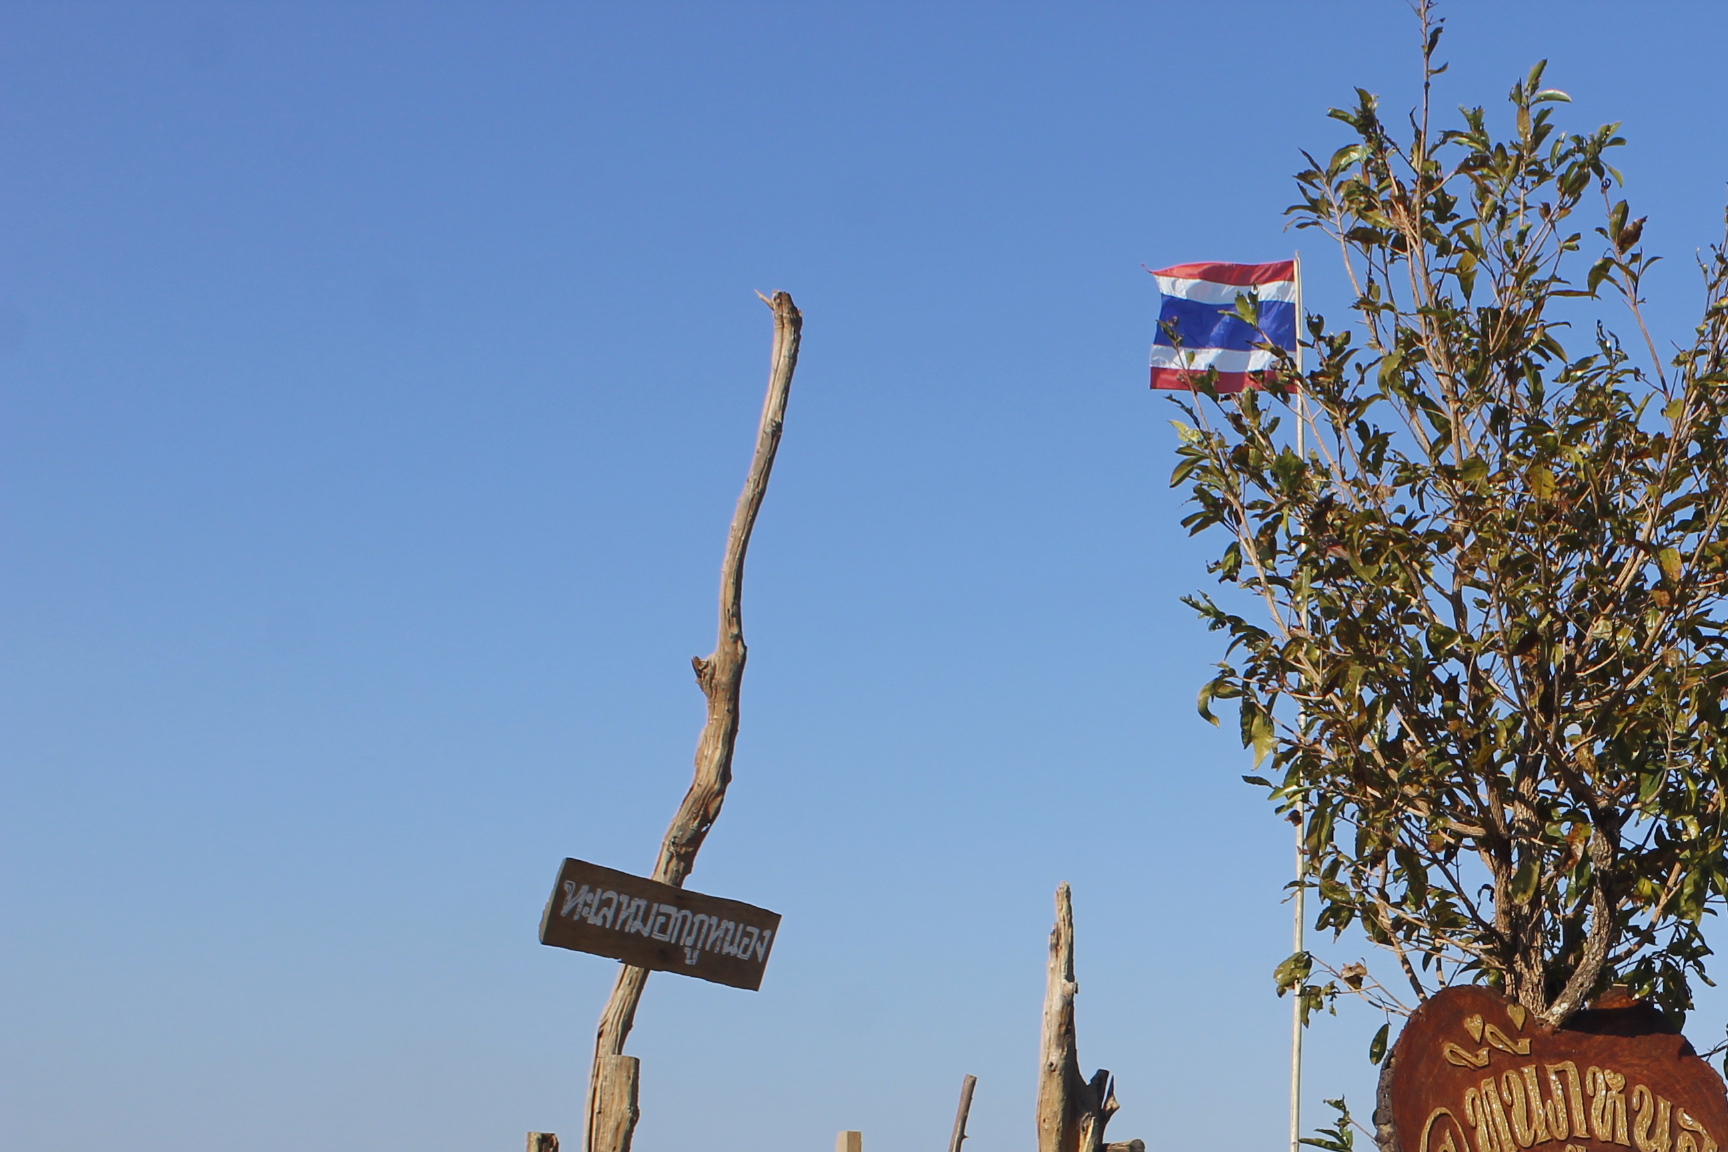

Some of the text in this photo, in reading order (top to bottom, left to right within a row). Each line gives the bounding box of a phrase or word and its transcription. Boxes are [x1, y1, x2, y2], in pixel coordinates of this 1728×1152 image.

[560, 880, 773, 966] ทะเลหมอกภูหนอง
